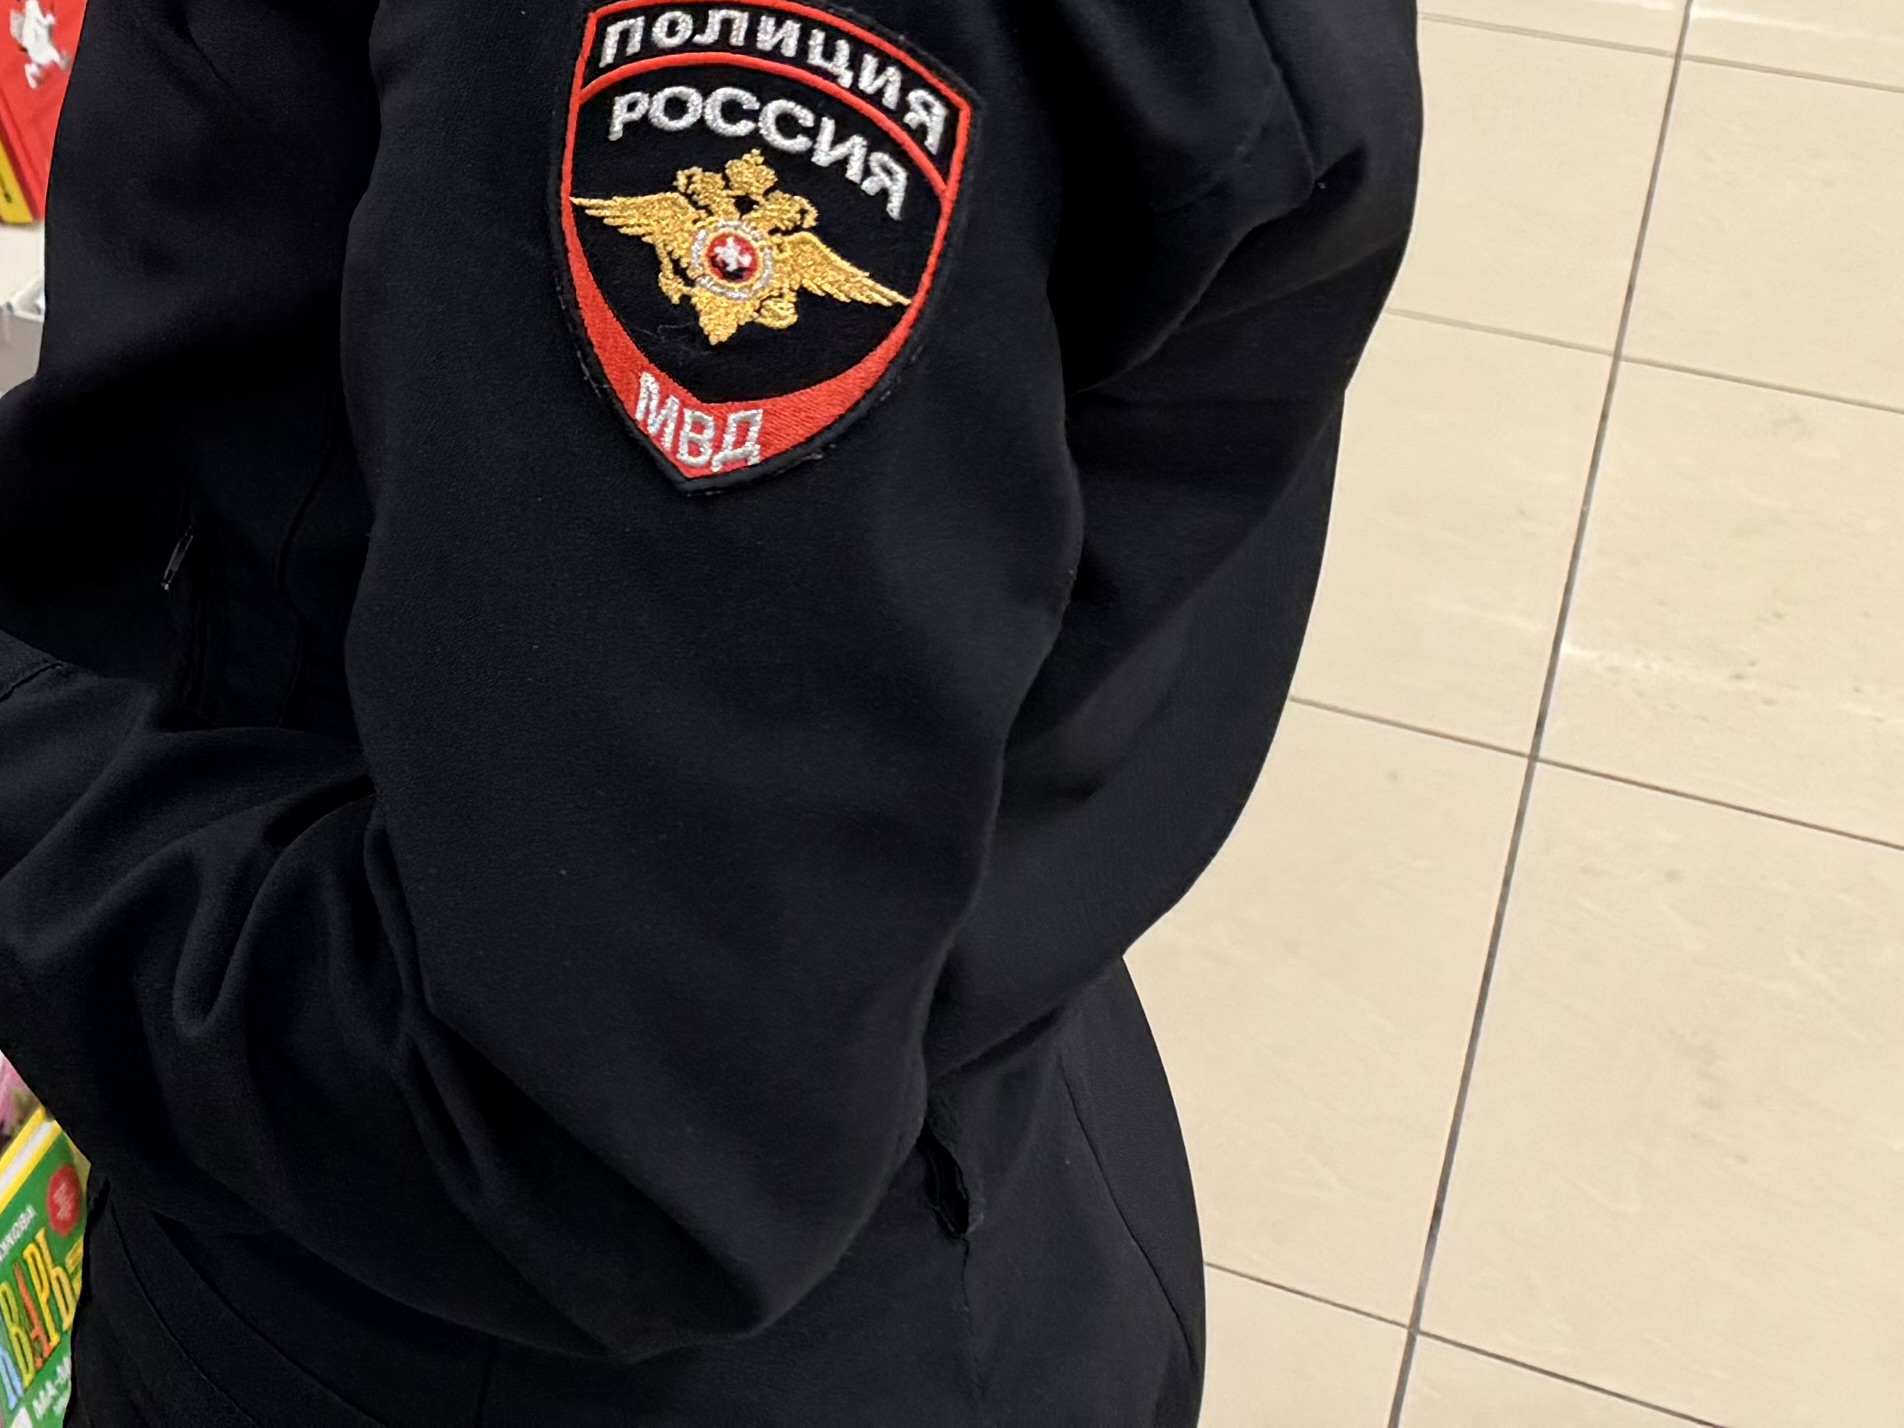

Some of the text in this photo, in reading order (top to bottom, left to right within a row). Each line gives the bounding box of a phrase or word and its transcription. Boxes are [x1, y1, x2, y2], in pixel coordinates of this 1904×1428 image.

[598, 7, 950, 155] ПОЛИЦИЯ
[607, 85, 910, 222] РОССИЯ
[635, 370, 764, 473] МВД
